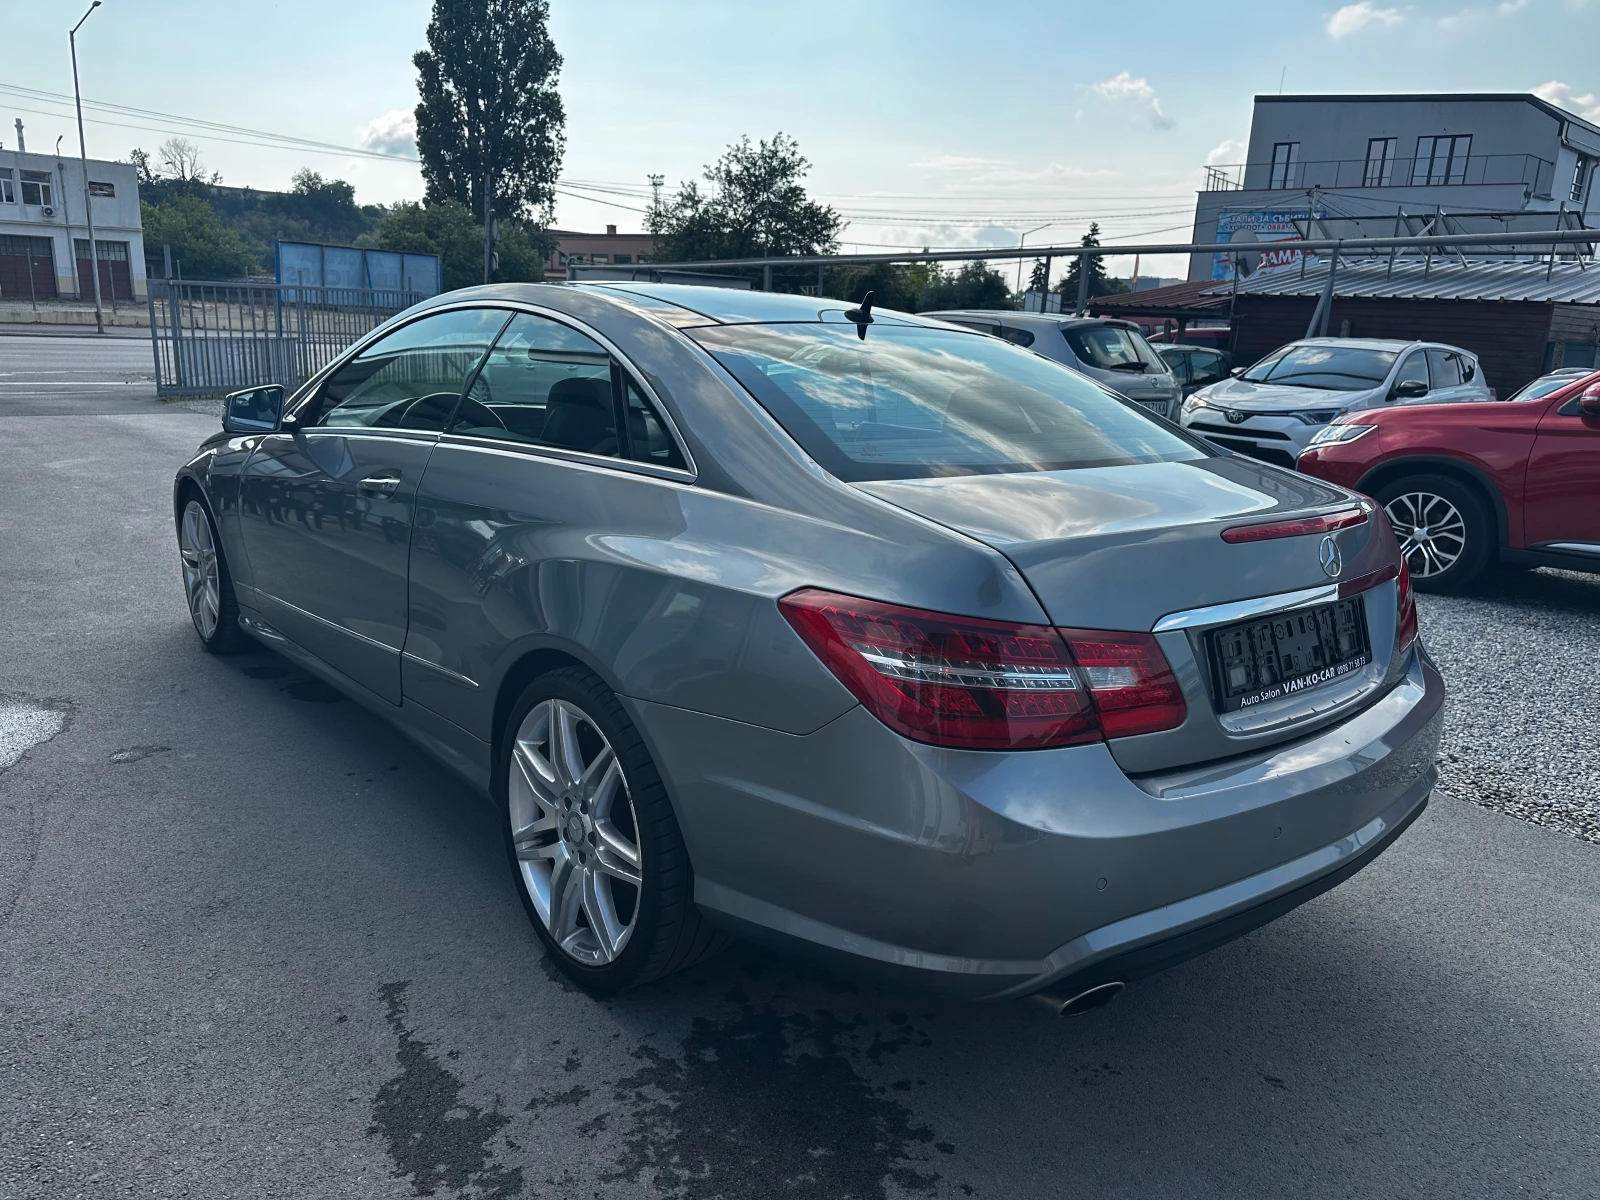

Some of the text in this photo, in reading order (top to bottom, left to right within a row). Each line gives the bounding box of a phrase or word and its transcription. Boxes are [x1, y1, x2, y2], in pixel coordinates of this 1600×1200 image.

[1230, 215, 1255, 223] ЗАЛИ
[1258, 215, 1270, 223] ЗА
[1240, 696, 1260, 707] Auto
[1260, 688, 1281, 701] Salon
[1283, 667, 1335, 693] VAN-KO-CAR
